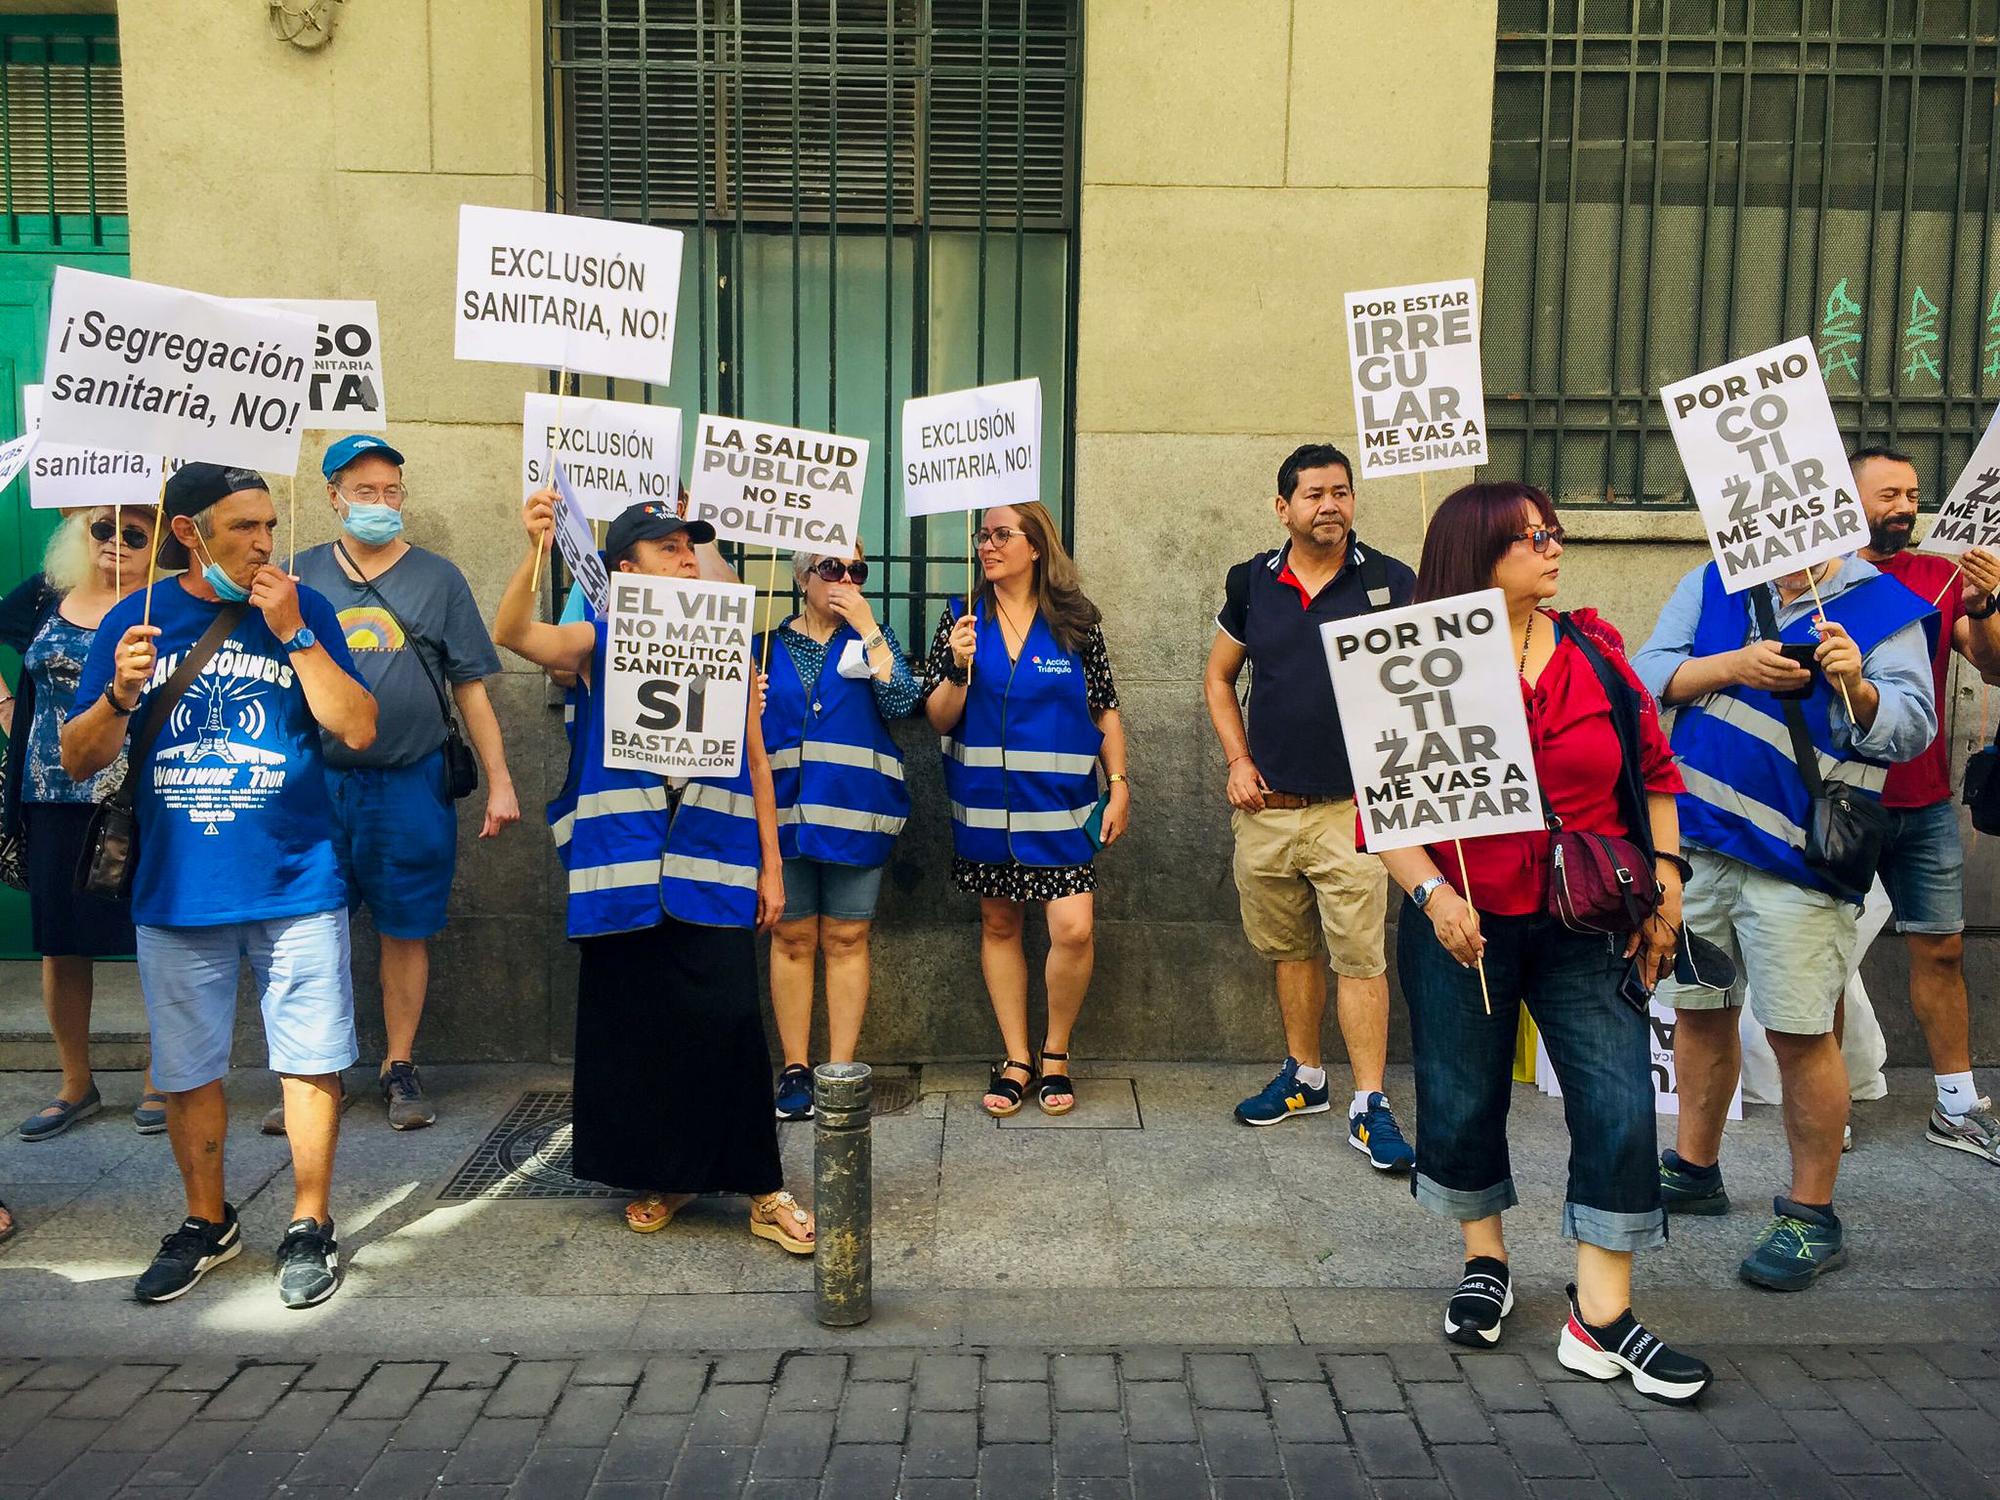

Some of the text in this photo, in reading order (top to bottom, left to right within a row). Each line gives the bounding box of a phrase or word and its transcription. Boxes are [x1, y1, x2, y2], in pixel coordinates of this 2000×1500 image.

[491, 246, 645, 292] EXCLUSIÓN
[463, 290, 667, 340] SANITARIA, NO!
[1353, 291, 1469, 319] POR ESTAR
[59, 310, 305, 383] ¡Segregación
[1354, 308, 1472, 357] IRRE
[312, 360, 375, 371] NITARIA
[1357, 351, 1427, 392] GU
[1673, 353, 1808, 419] POR NO
[51, 373, 301, 434] sanitaria, NO!
[1361, 386, 1461, 430] LAR
[1716, 394, 1788, 443] CO
[546, 426, 653, 460] EXCLUSIÓN
[705, 425, 858, 468] LA SALUD
[922, 408, 1016, 449] EXCLUSIÓN
[1365, 420, 1479, 448] ME VAS A
[34, 449, 153, 477] sanitaria,
[907, 445, 1032, 486] SANITARIA, NO!
[1366, 439, 1482, 468] ASESINAR
[1736, 430, 1790, 474] TI
[528, 460, 671, 498] SITARIA, NO!
[742, 485, 812, 509] NO ES
[698, 503, 848, 546] POLÍTICA
[1716, 488, 1854, 549] ME VAS A
[1943, 501, 1978, 520] ME
[1722, 509, 1862, 576] MATAR
[616, 585, 664, 616] EL
[677, 591, 748, 624] VIH
[614, 639, 743, 664] TU POLÍTICA
[615, 618, 746, 647] NO MATA
[1336, 607, 1494, 661] POR NO
[614, 656, 742, 681] SANITARIA
[1380, 648, 1463, 695] CO
[1399, 688, 1456, 731] TI
[611, 730, 736, 755] BASTA DE
[612, 747, 735, 767] DISCRIMINACIÓN
[1364, 763, 1528, 805] ME VAS A
[1369, 787, 1532, 834] MATAR
